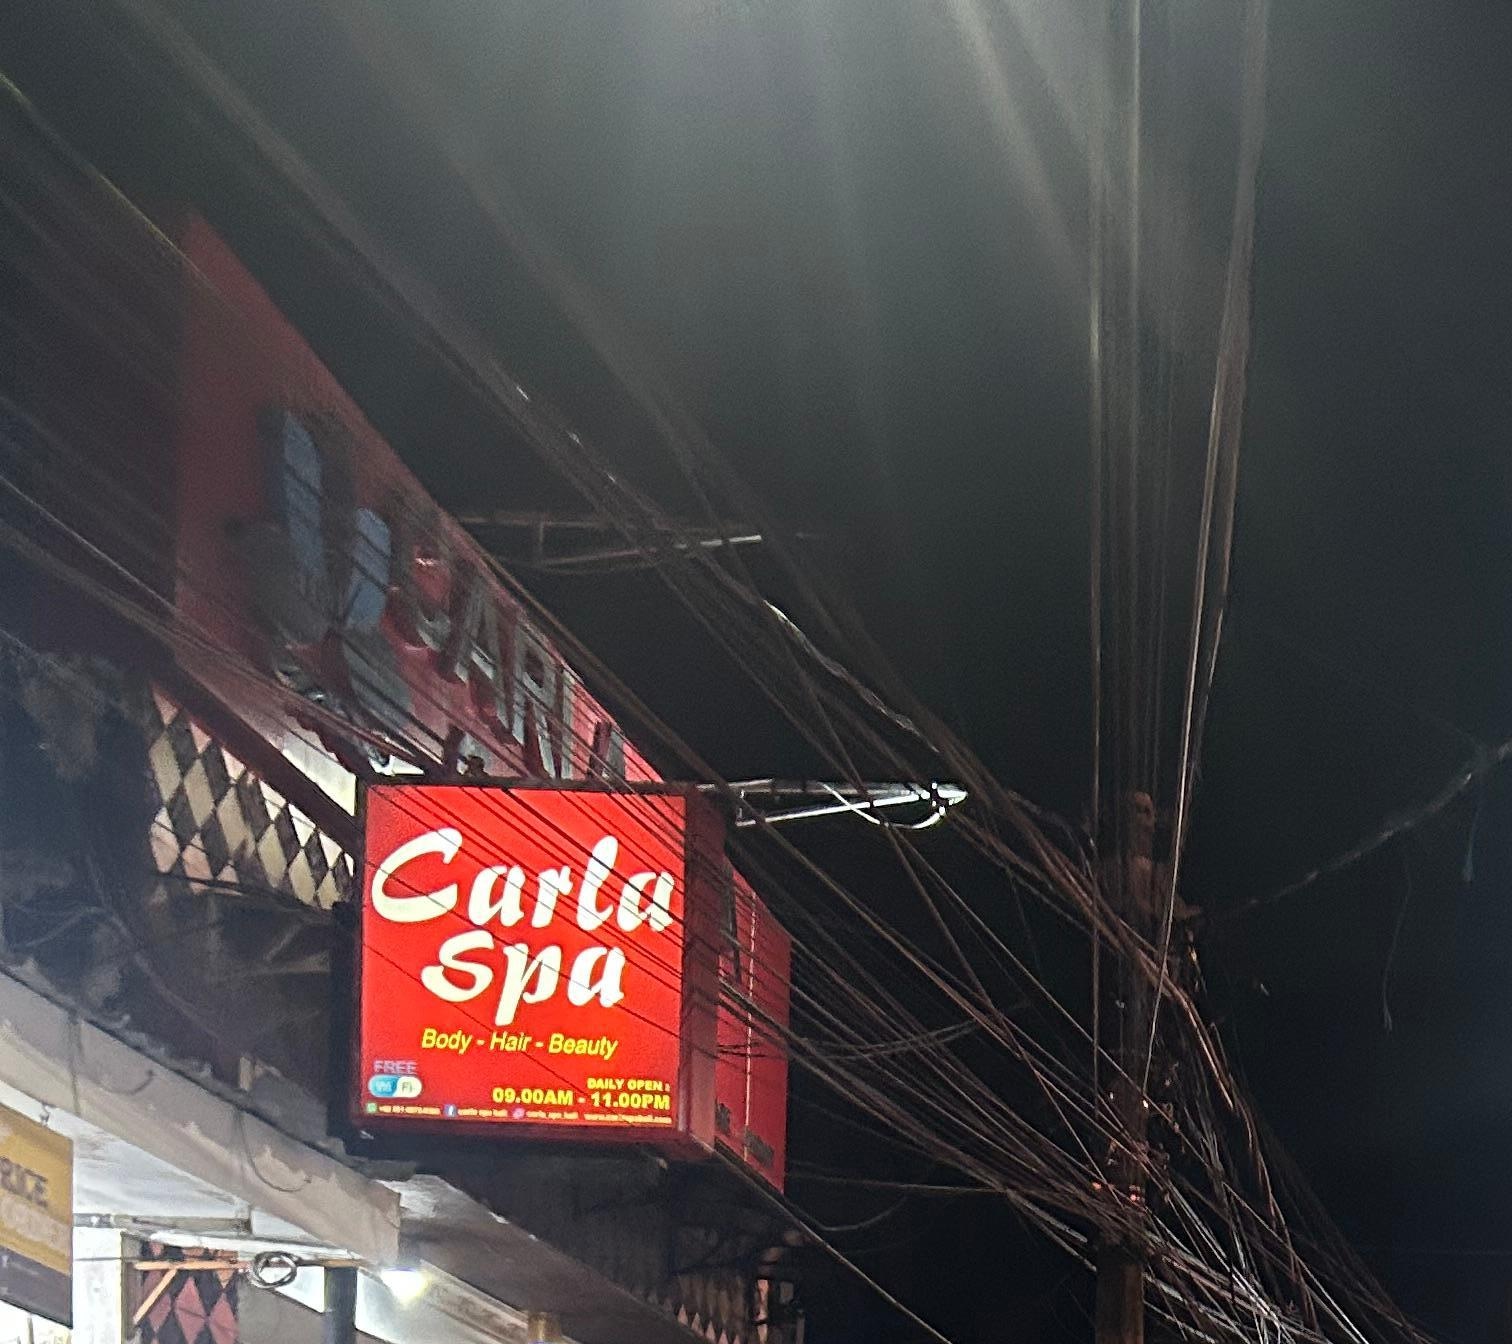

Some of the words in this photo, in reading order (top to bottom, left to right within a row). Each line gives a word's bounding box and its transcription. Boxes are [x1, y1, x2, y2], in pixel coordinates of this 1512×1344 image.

[371, 826, 676, 932] Carla
[421, 1027, 473, 1055] Body
[490, 1031, 533, 1052] Hair
[548, 1033, 619, 1060] Beauty
[373, 1060, 419, 1074] FREE
[586, 1077, 625, 1091] DAILY
[627, 1079, 664, 1093] OPEN
[492, 1088, 574, 1106] 09.00AM
[590, 1092, 671, 1111] 11.00PM
